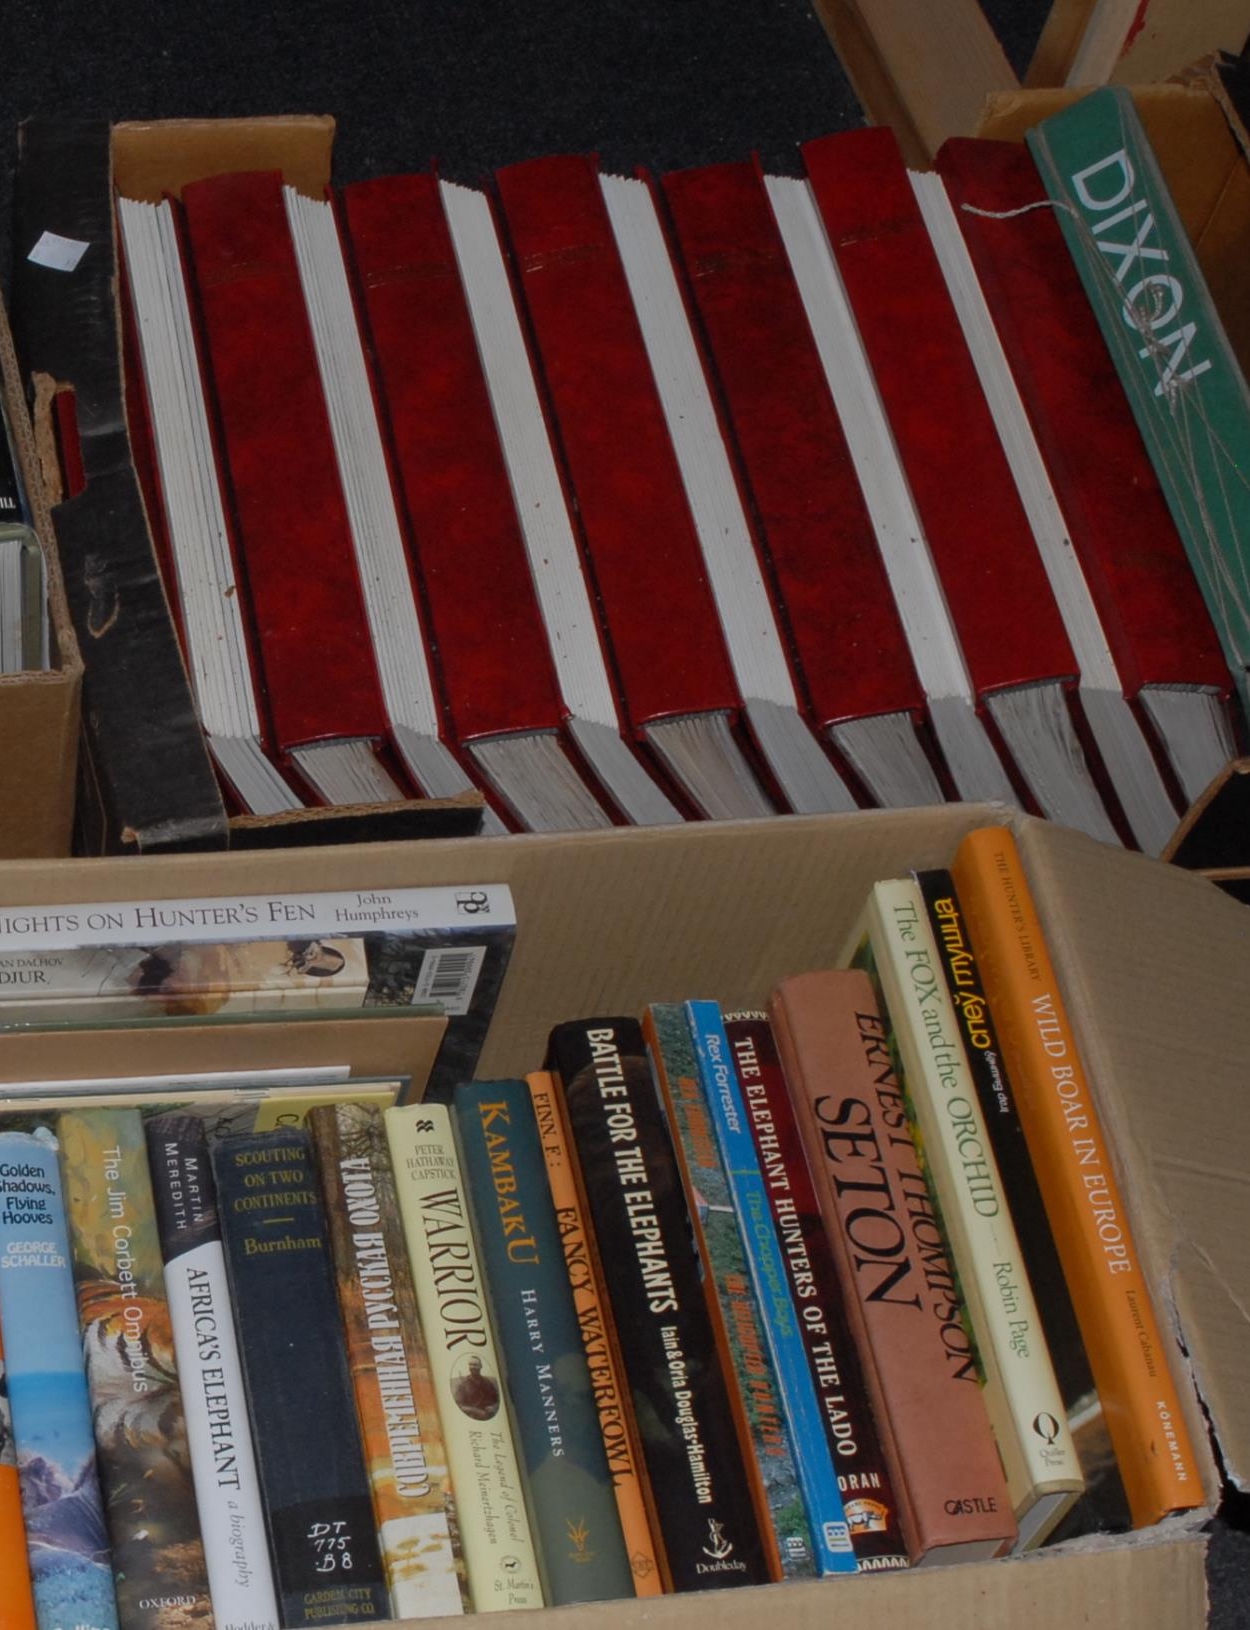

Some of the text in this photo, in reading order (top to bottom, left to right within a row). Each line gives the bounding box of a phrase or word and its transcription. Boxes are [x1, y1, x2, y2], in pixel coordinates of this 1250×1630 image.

[1071, 149, 1212, 397] DIXON
[87, 912, 124, 931] ON
[269, 901, 317, 923] FEN
[894, 900, 999, 1217] The FOX and the ORCHID
[0, 1164, 45, 1178] Golden
[235, 1148, 306, 1167] SCOUTING
[587, 1027, 679, 1313] BATTLE FOR THE ELEPHANTS
[1032, 992, 1132, 1274] WILD BOAR IN EUROPE
[2, 1211, 54, 1225] Hooves
[6, 1196, 46, 1210] Flying
[165, 1143, 187, 1231] MEREDITH
[184, 1157, 204, 1223] MARTIN
[233, 1192, 317, 1211] CONTINENTS
[244, 1170, 304, 1186] ON TWO
[340, 1157, 381, 1226] ОХОТА
[478, 1101, 540, 1265] KAMBAKU
[814, 1096, 924, 1313] SETON
[854, 1009, 981, 1385] ERNEST THOMPSON
[103, 1146, 148, 1392] The Jim Corbett Omnibus
[244, 1236, 322, 1257] Burnham
[353, 1231, 400, 1330] РУССКАЯ
[419, 1187, 488, 1350] WARRIOR
[734, 1036, 858, 1456] THE ELEPHANT HUNTERS OF THE LADO
[555, 1206, 635, 1487] FANCY WATERFOWL
[992, 1260, 1030, 1359] Robin Page
[201, 1367, 240, 1490] ELEPHANT
[1156, 1400, 1188, 1482] KÖNEMANN
[944, 1496, 998, 1515] CASTLE
[139, 1595, 196, 1609] OXFORD
[695, 1559, 748, 1574] Doubleday
